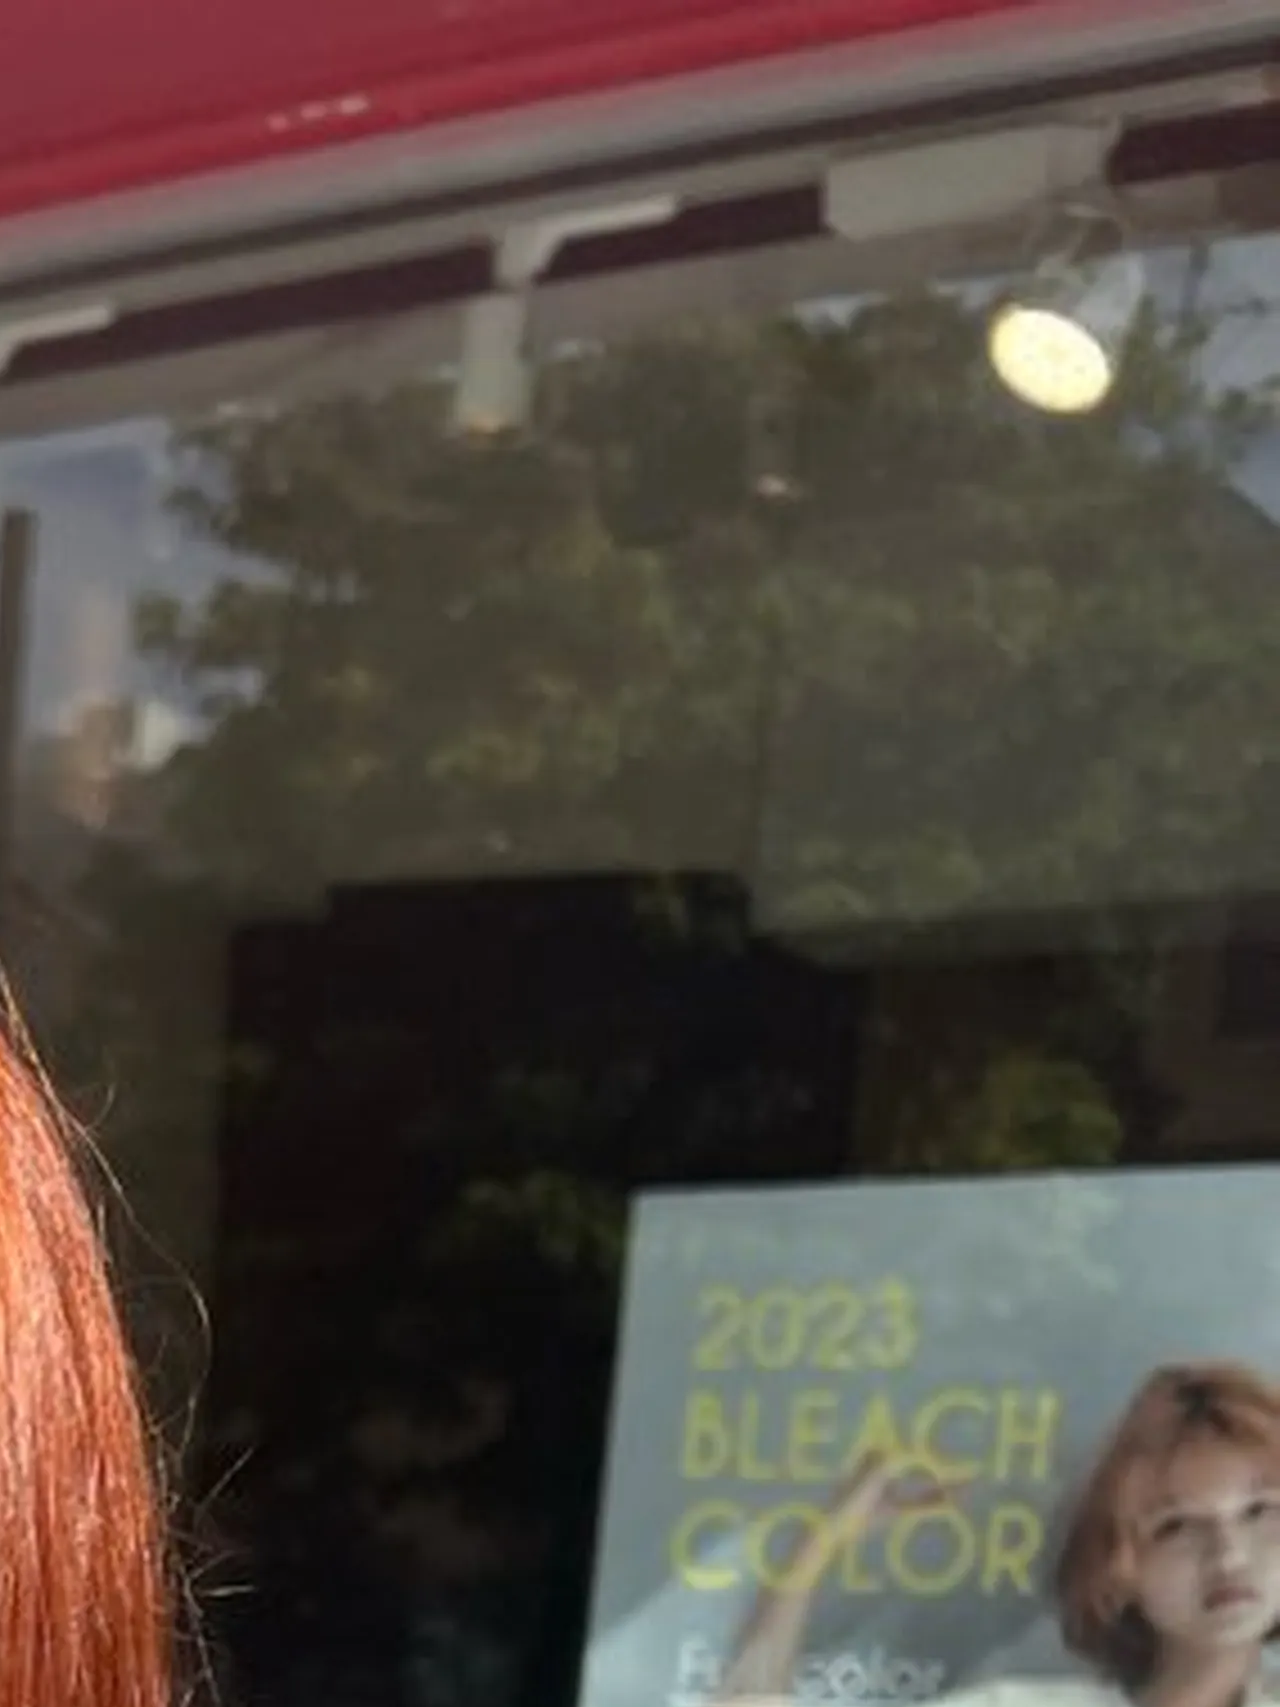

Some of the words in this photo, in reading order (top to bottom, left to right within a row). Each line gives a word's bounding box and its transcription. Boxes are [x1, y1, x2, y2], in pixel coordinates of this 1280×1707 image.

[696, 1280, 916, 1368] 2023
[682, 1391, 1061, 1481] BLEACH
[673, 1503, 1042, 1592] COLOR
